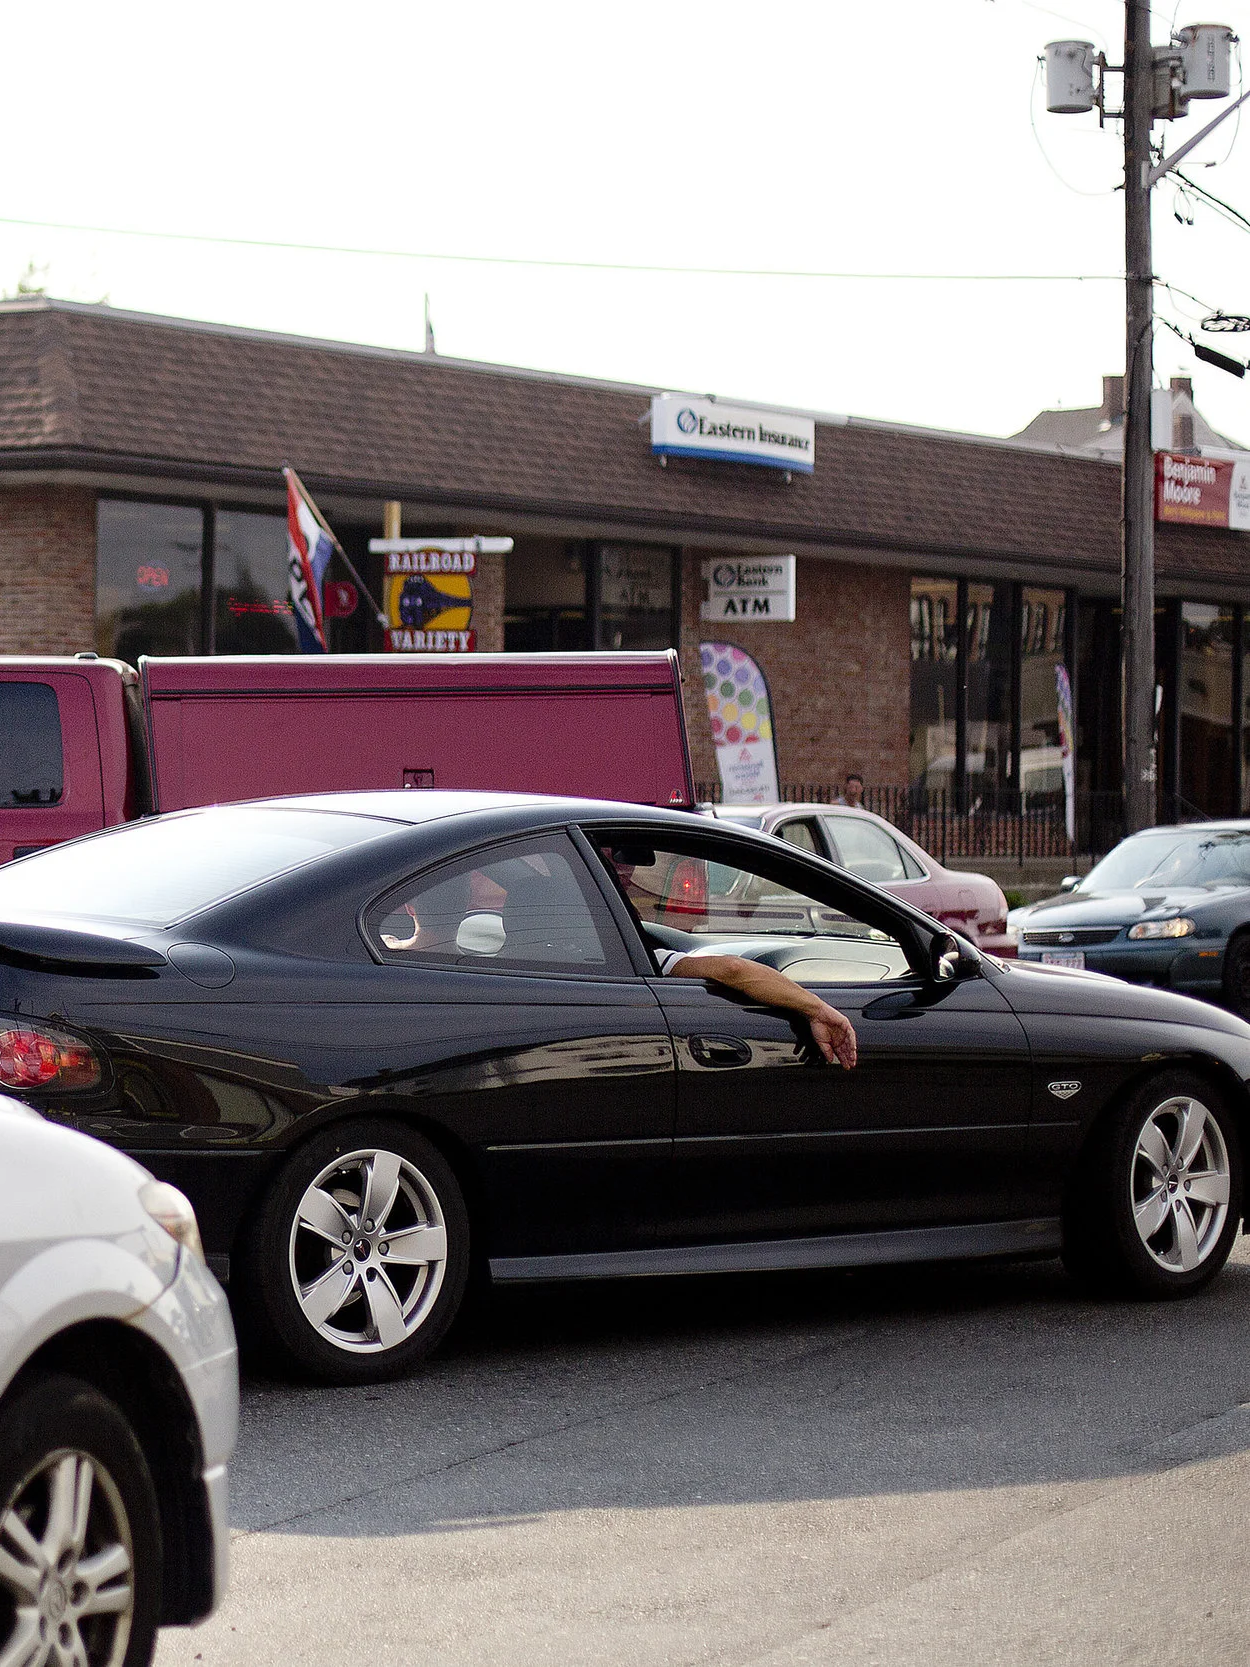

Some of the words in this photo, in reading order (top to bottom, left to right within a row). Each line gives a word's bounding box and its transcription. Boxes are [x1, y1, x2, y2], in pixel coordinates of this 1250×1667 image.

[698, 415, 756, 442] Eastern
[1163, 455, 1217, 485] Benjamin
[1163, 480, 1202, 506] Moore
[388, 552, 475, 573] RAILROAD
[737, 563, 783, 575] Eastern
[737, 574, 769, 586] Bank
[724, 597, 770, 615] ATM
[389, 630, 471, 651] VARIETY
[1051, 1083, 1078, 1091] GTO
